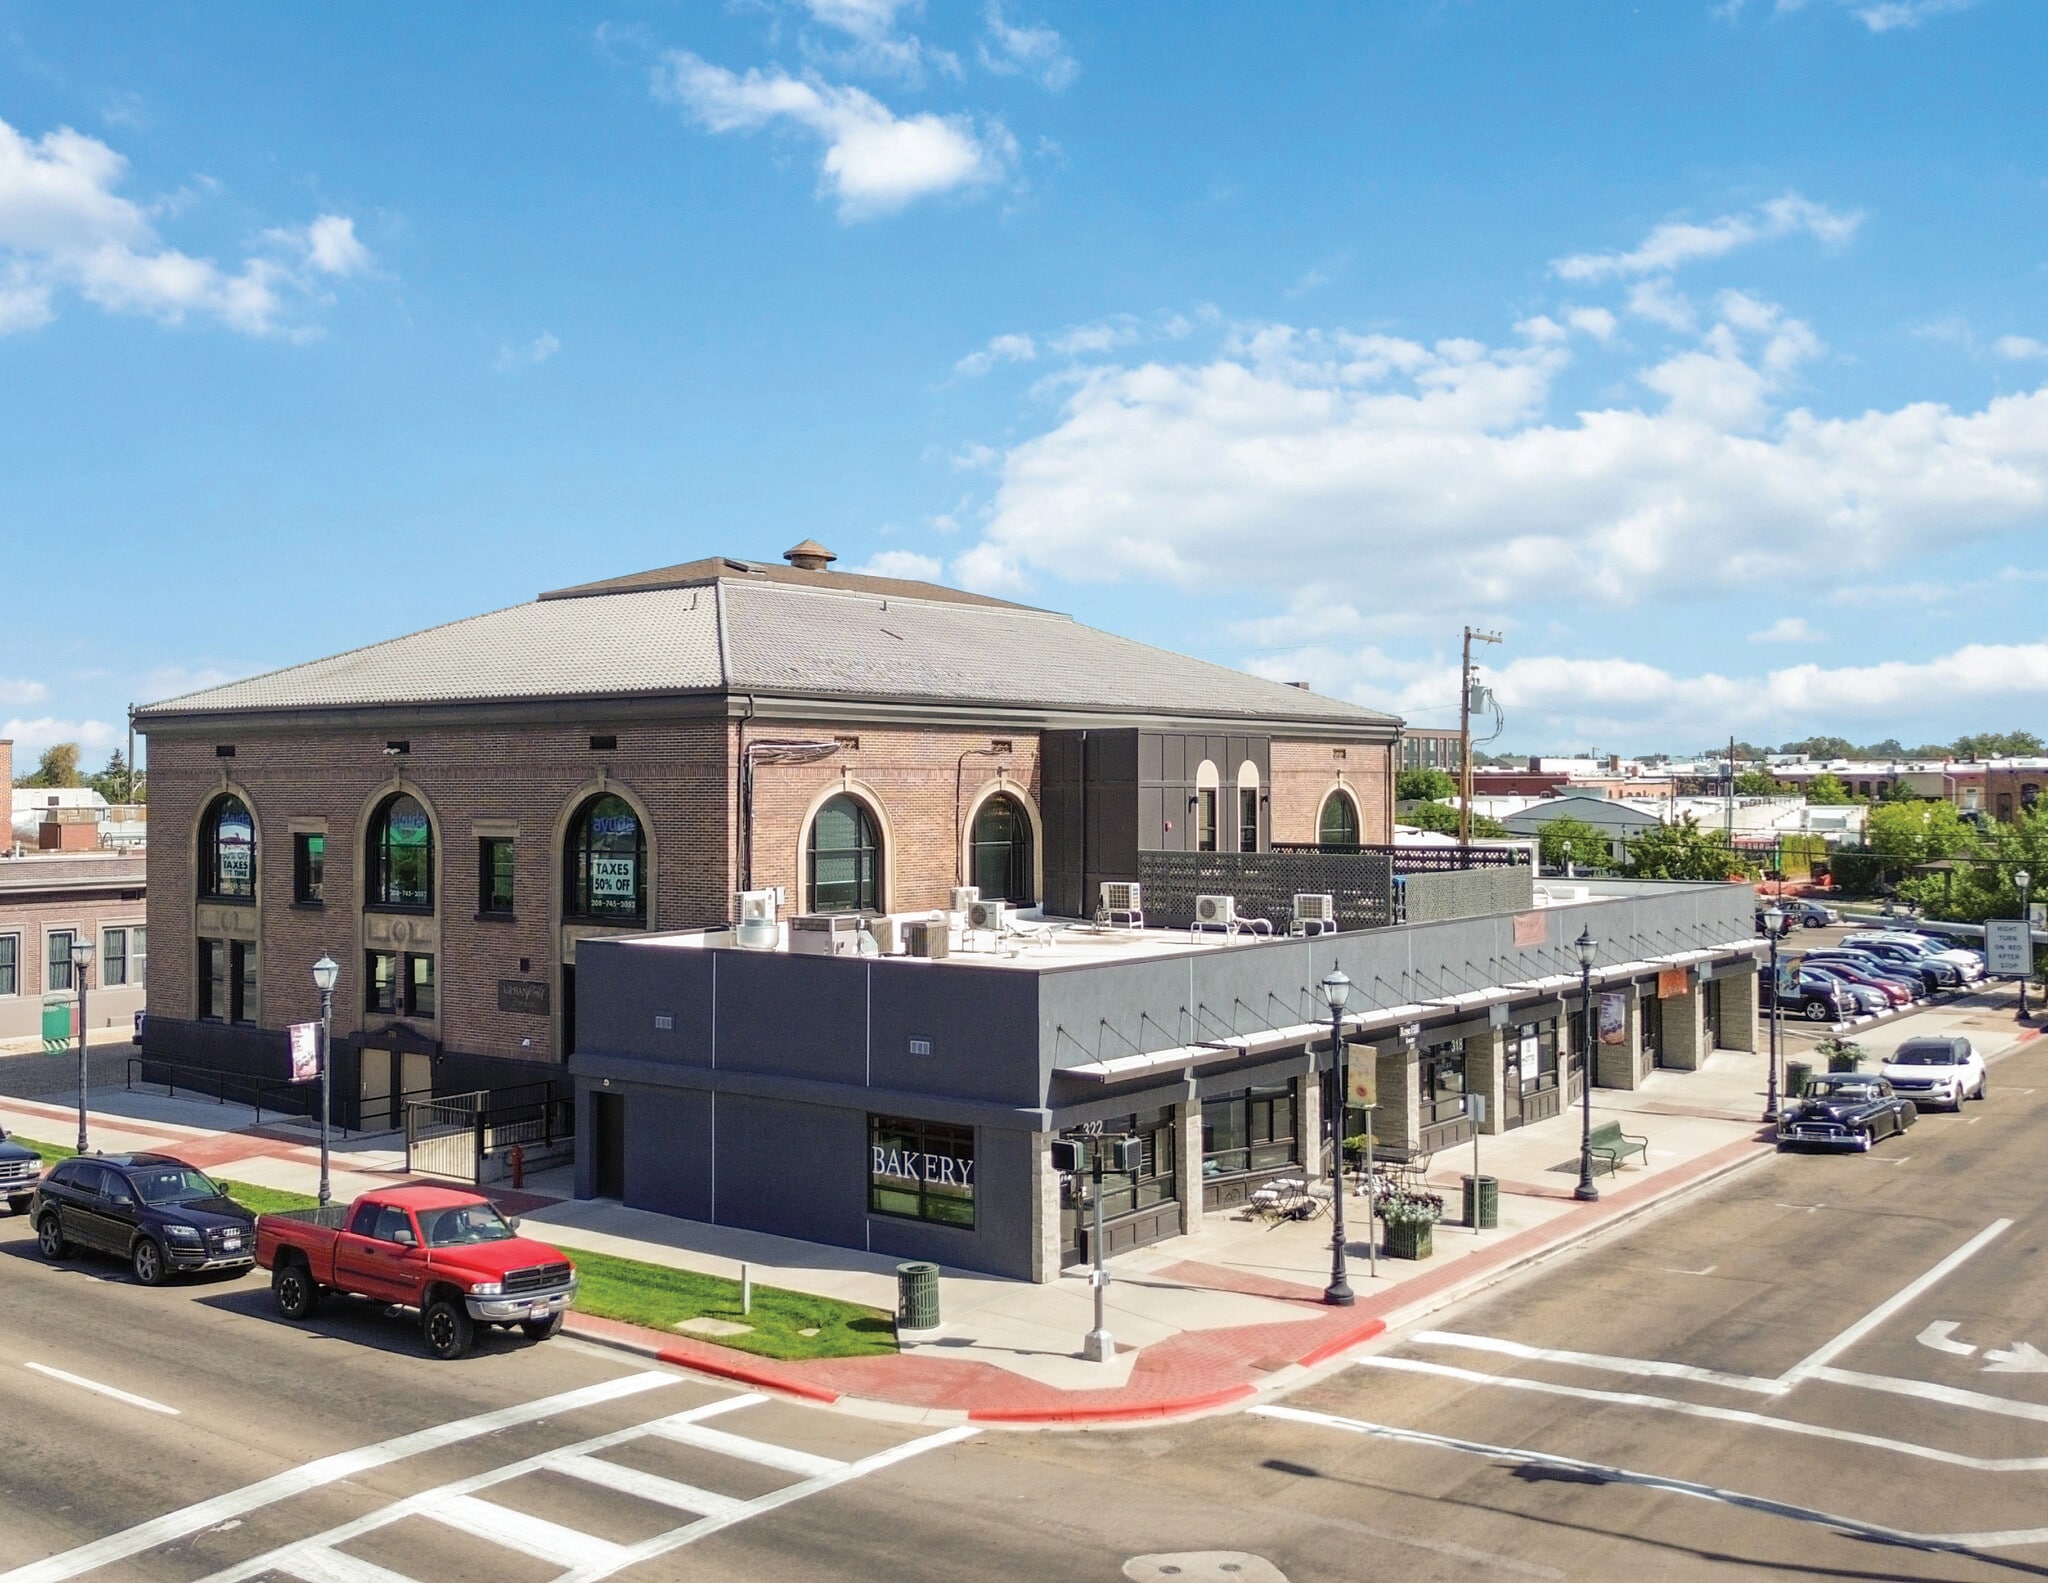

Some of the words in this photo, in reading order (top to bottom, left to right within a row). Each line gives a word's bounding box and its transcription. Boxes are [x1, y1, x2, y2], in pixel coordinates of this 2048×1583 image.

[593, 815, 637, 834] ayuda
[223, 860, 248, 870] TAXES
[596, 863, 630, 876] TAXES
[595, 878, 613, 891] 50%
[615, 879, 631, 891] OFF
[1451, 1038, 1463, 1053] 318
[1083, 1120, 1103, 1134] 322
[872, 1146, 974, 1188] BAKERY
